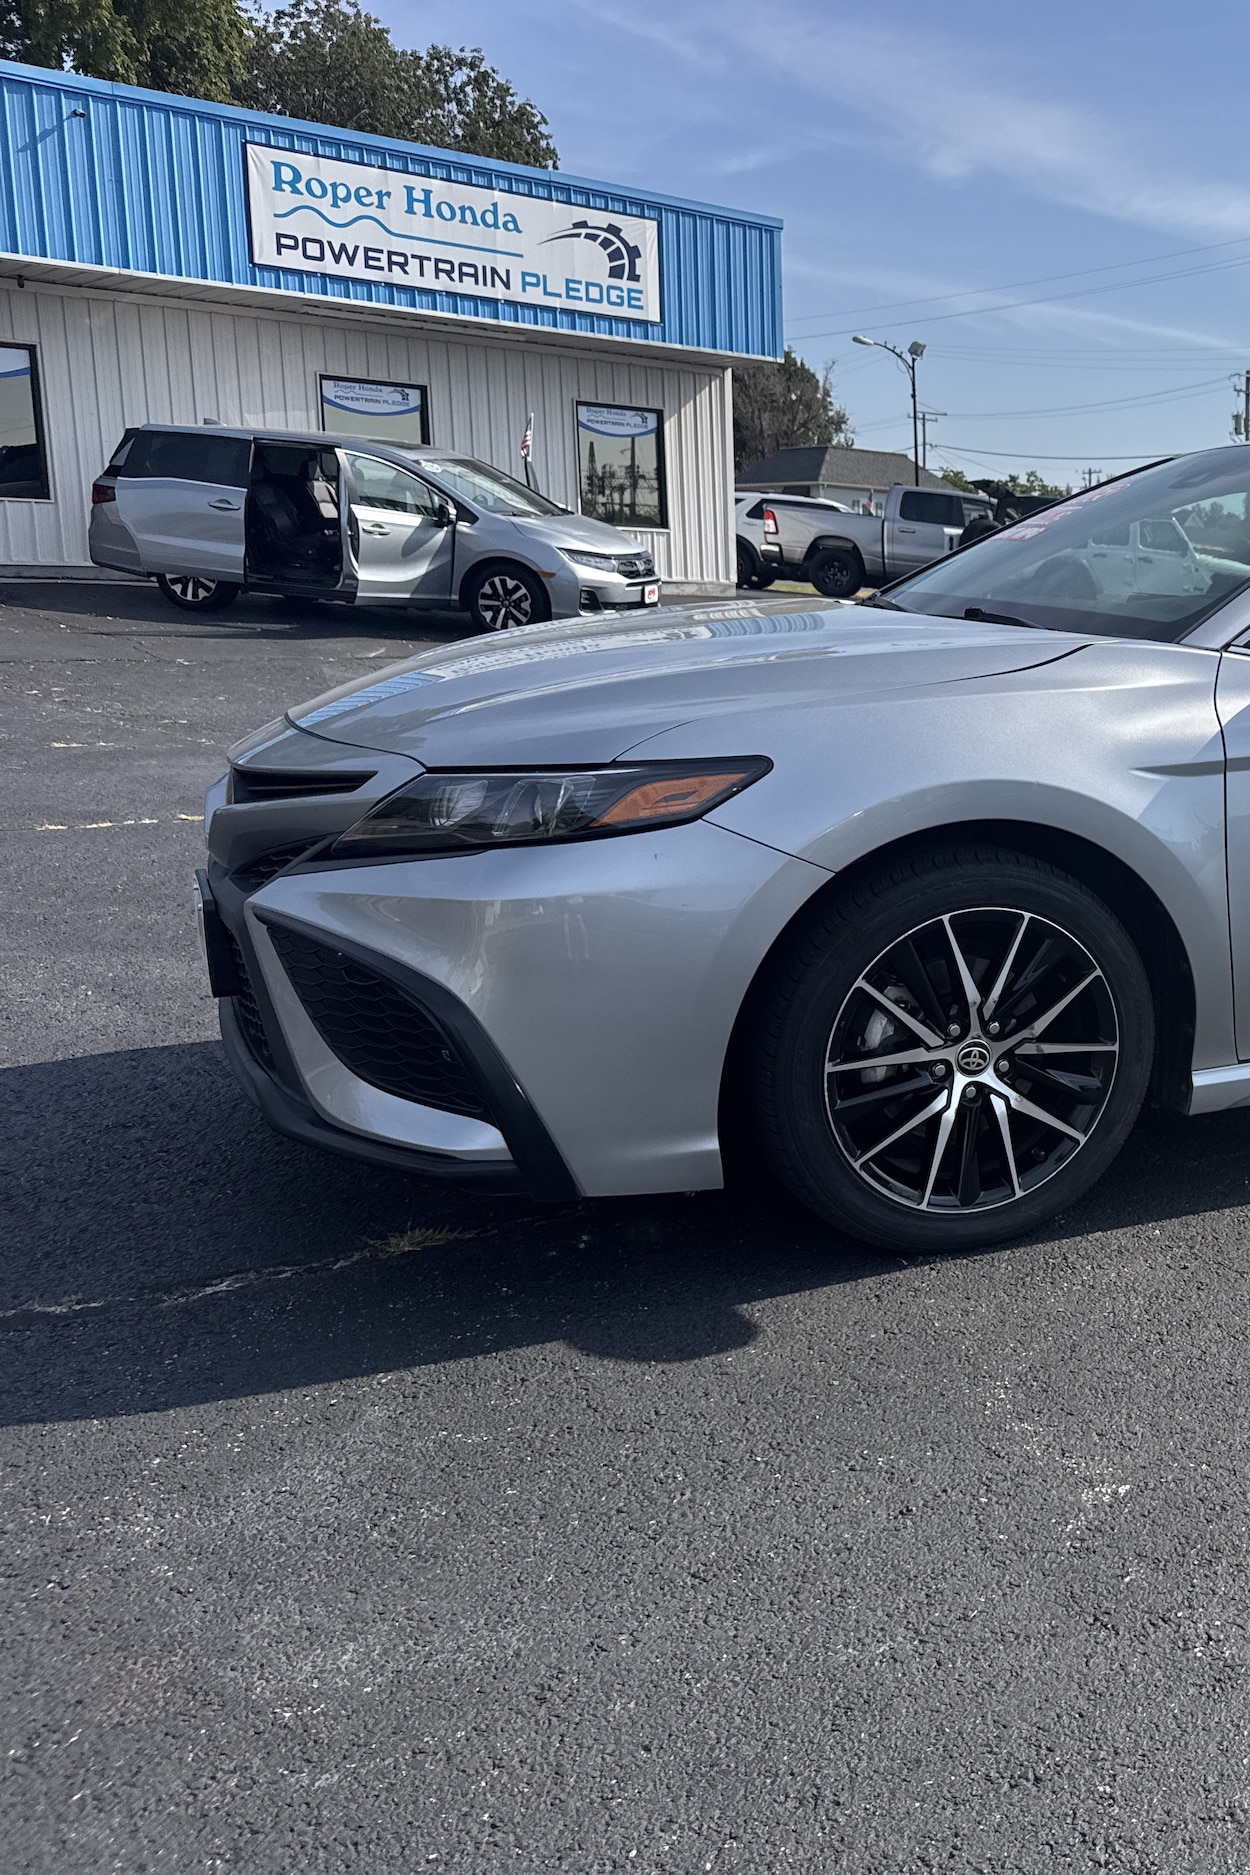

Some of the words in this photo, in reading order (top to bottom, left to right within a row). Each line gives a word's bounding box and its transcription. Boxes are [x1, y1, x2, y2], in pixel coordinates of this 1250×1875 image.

[271, 160, 391, 210] Roper
[404, 185, 523, 234] Honda
[275, 232, 511, 290] POWERTRAIN
[521, 270, 644, 311] PLEDGE
[334, 394, 380, 404] POWERTRAIN
[382, 399, 410, 407] PLEDGE
